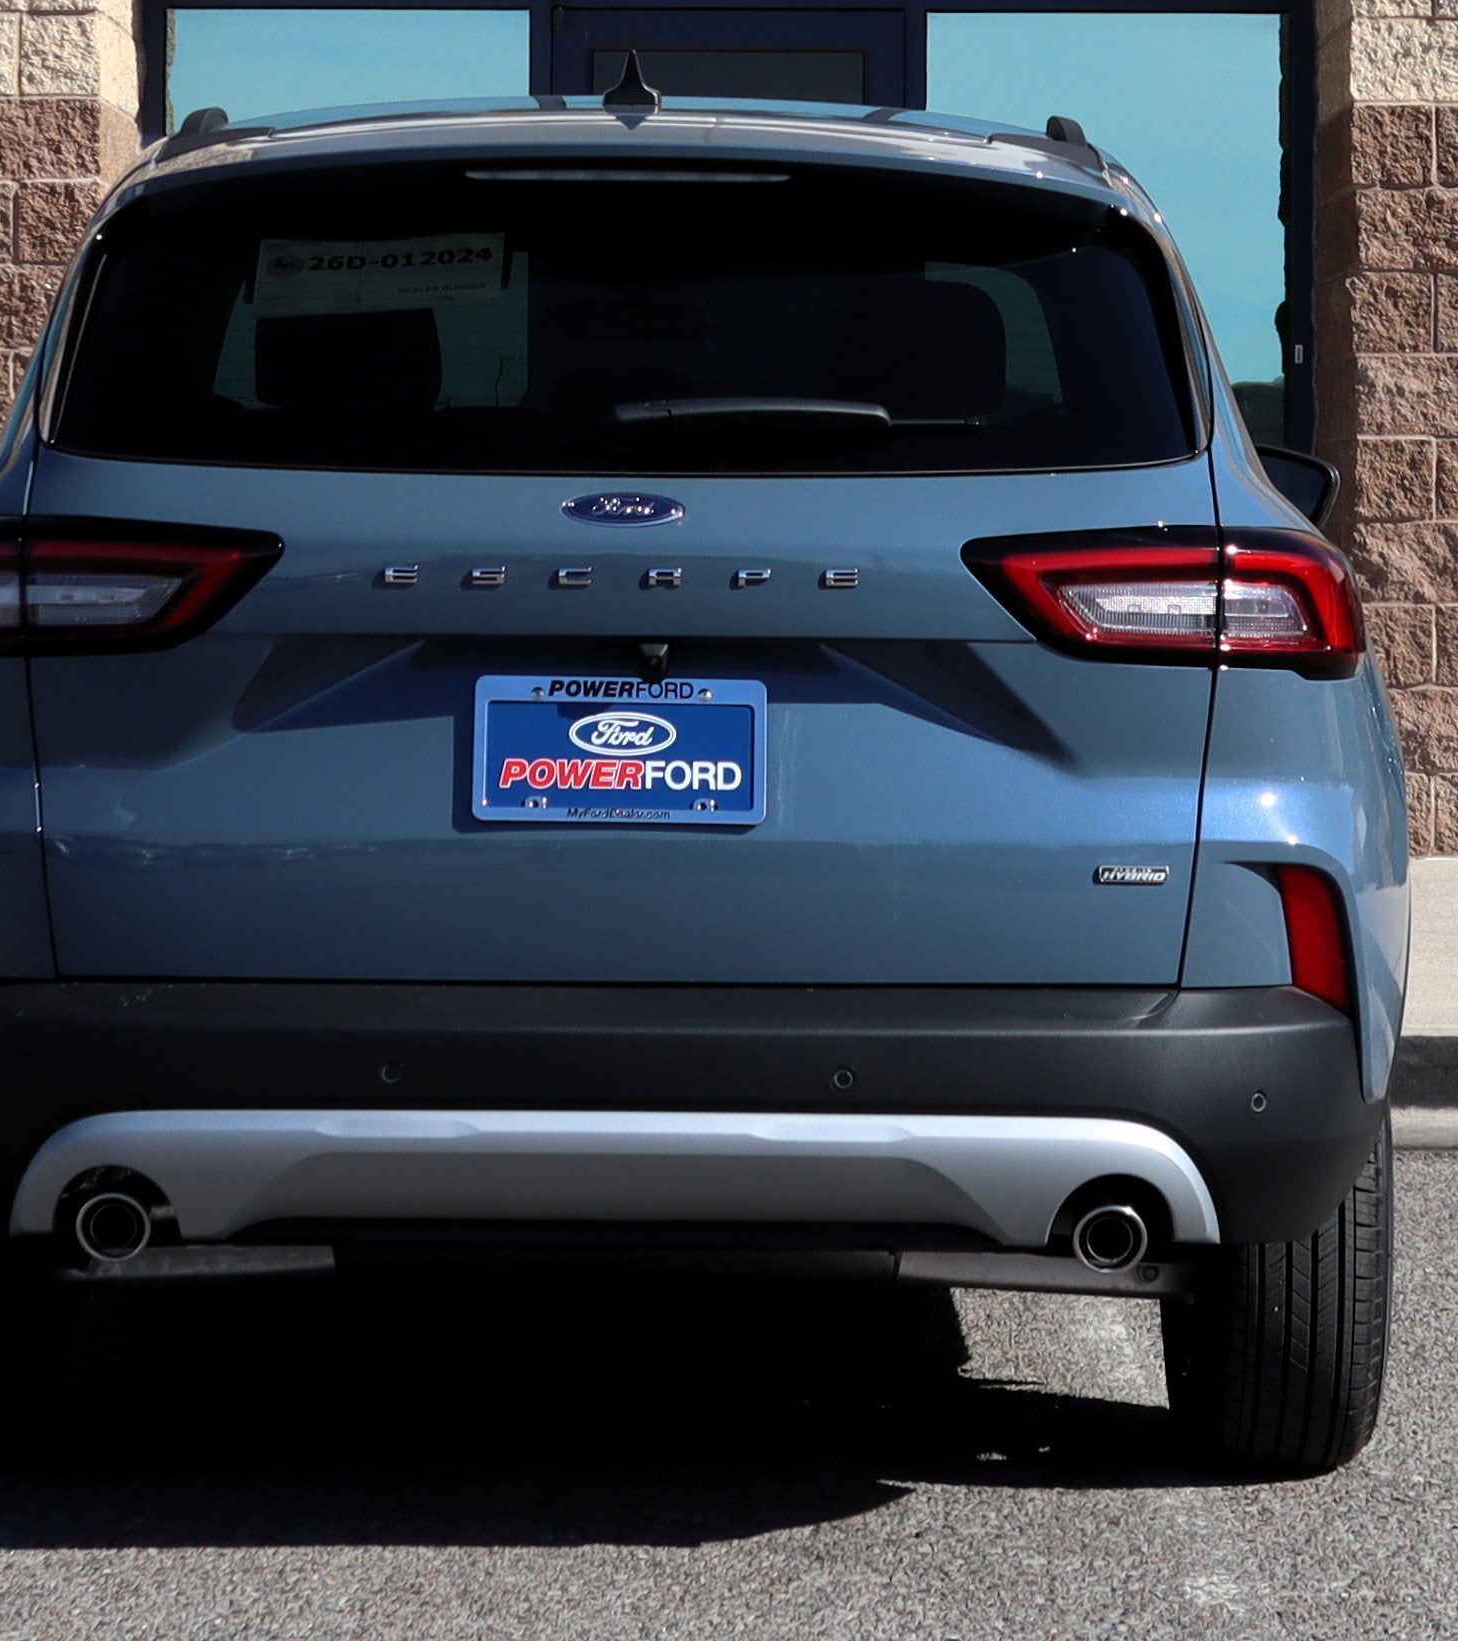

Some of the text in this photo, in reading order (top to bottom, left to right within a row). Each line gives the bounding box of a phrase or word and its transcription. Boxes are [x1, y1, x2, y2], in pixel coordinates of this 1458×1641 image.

[308, 246, 493, 271] 26D-012024
[592, 497, 655, 515] Ford
[384, 565, 859, 585] ESCAPE
[591, 720, 654, 746] Ford
[1102, 870, 1166, 881] HYBRID
